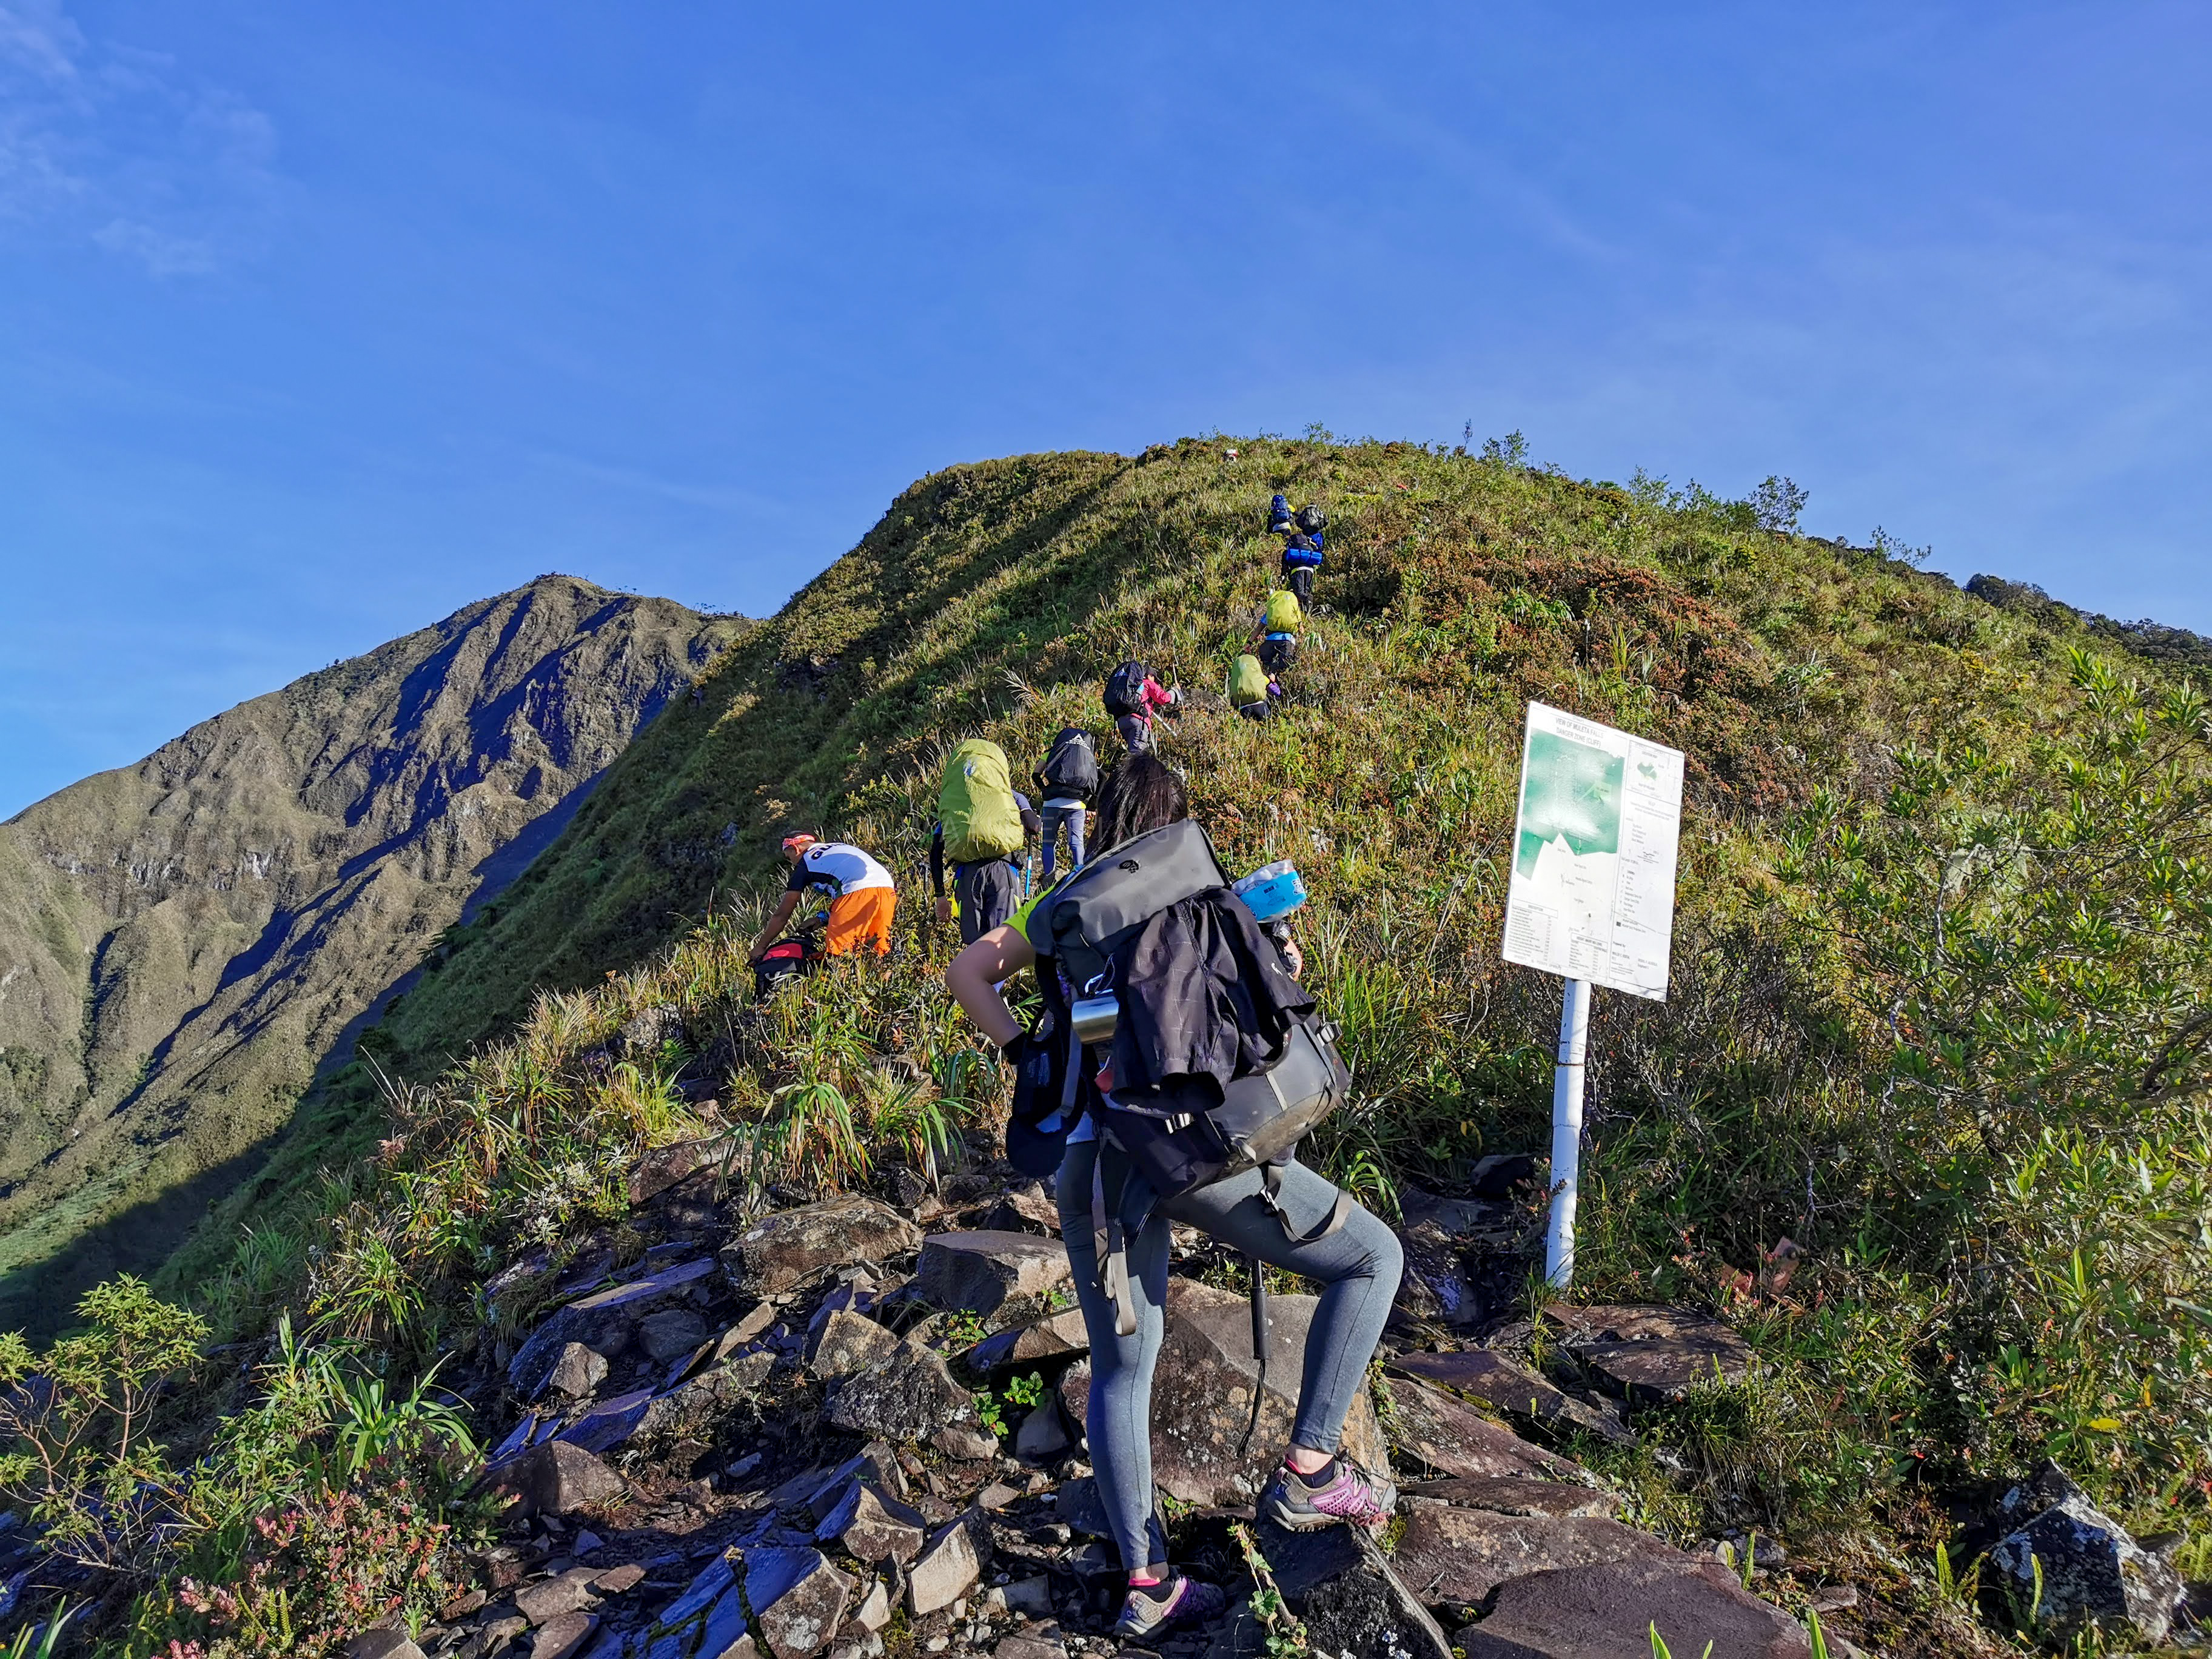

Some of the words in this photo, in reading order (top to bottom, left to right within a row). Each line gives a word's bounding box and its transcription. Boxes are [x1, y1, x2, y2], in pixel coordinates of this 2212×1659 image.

[1555, 717, 1566, 726] VIEW
[1573, 723, 1589, 734] MULETA
[1590, 729, 1604, 739] FALLS
[1556, 727, 1574, 739] DANGER
[1574, 732, 1586, 743] ZONE
[1586, 737, 1601, 748] (CLIFF)
